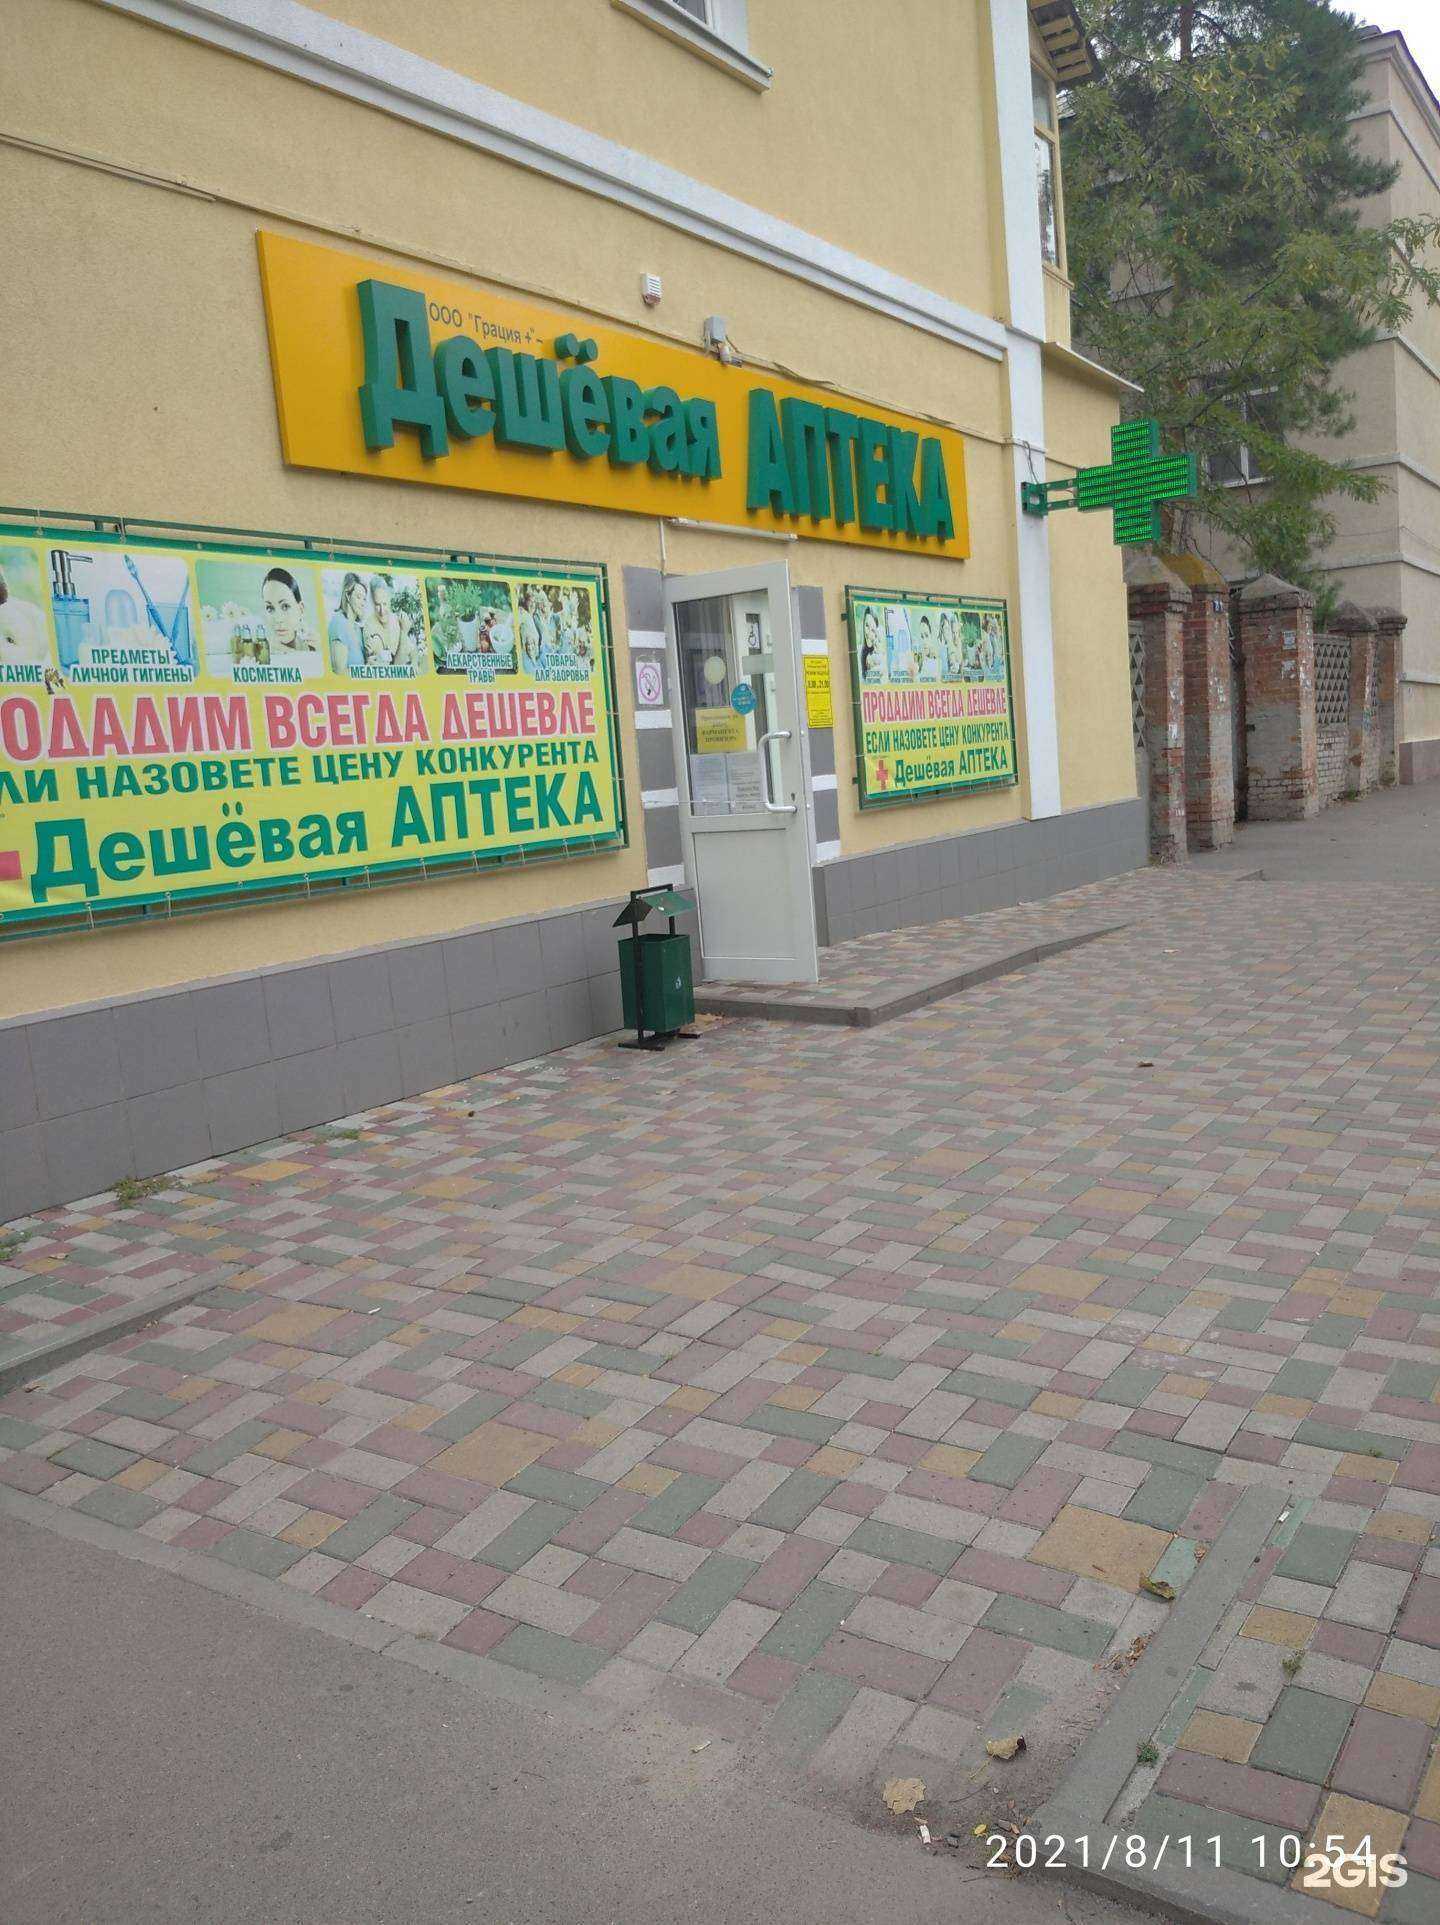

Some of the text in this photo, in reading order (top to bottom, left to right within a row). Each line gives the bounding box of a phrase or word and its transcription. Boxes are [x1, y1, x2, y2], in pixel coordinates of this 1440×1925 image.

[429, 302, 463, 327] ООО
[357, 279, 955, 541] Дешёвая АПТЕКА
[91, 649, 170, 665] ПРЕДМЕТЫ
[447, 653, 514, 668] ЛЕКАРСТВЕННЫЕ
[546, 655, 576, 667] ТОВАРЫ
[72, 667, 192, 683] ЛИЧНОЙ ГИГИЕНЫ
[233, 667, 302, 683] КОСМЕТИКА
[351, 666, 416, 679] МЕДТЕХНИКА
[468, 669, 495, 683] ТРАВЫ
[535, 669, 590, 682] ДЛЯ ЗДОРОВЬЯ
[863, 690, 926, 723] ПРОДАДИМ
[928, 689, 964, 719] ВСЕГДА
[967, 687, 1007, 716] ДЕШЕВЛЕ
[0, 691, 596, 761] ОДАДИМ ВСЕГДА ДЕШЕВЛЕ
[866, 722, 1009, 753] ЕСЛИ НАЗОВЕТЕ ЦЕНУ КОНКУРЕНТА
[76, 757, 301, 800] НАЗОВЕТЕ
[312, 751, 403, 784] ЦЕНУ
[416, 740, 599, 776] КОНКУРЕНТА
[894, 746, 1008, 787] Дешёвая АПТЕКА
[30, 801, 369, 903] Дешёвая
[391, 771, 603, 848] АПТЕКА
